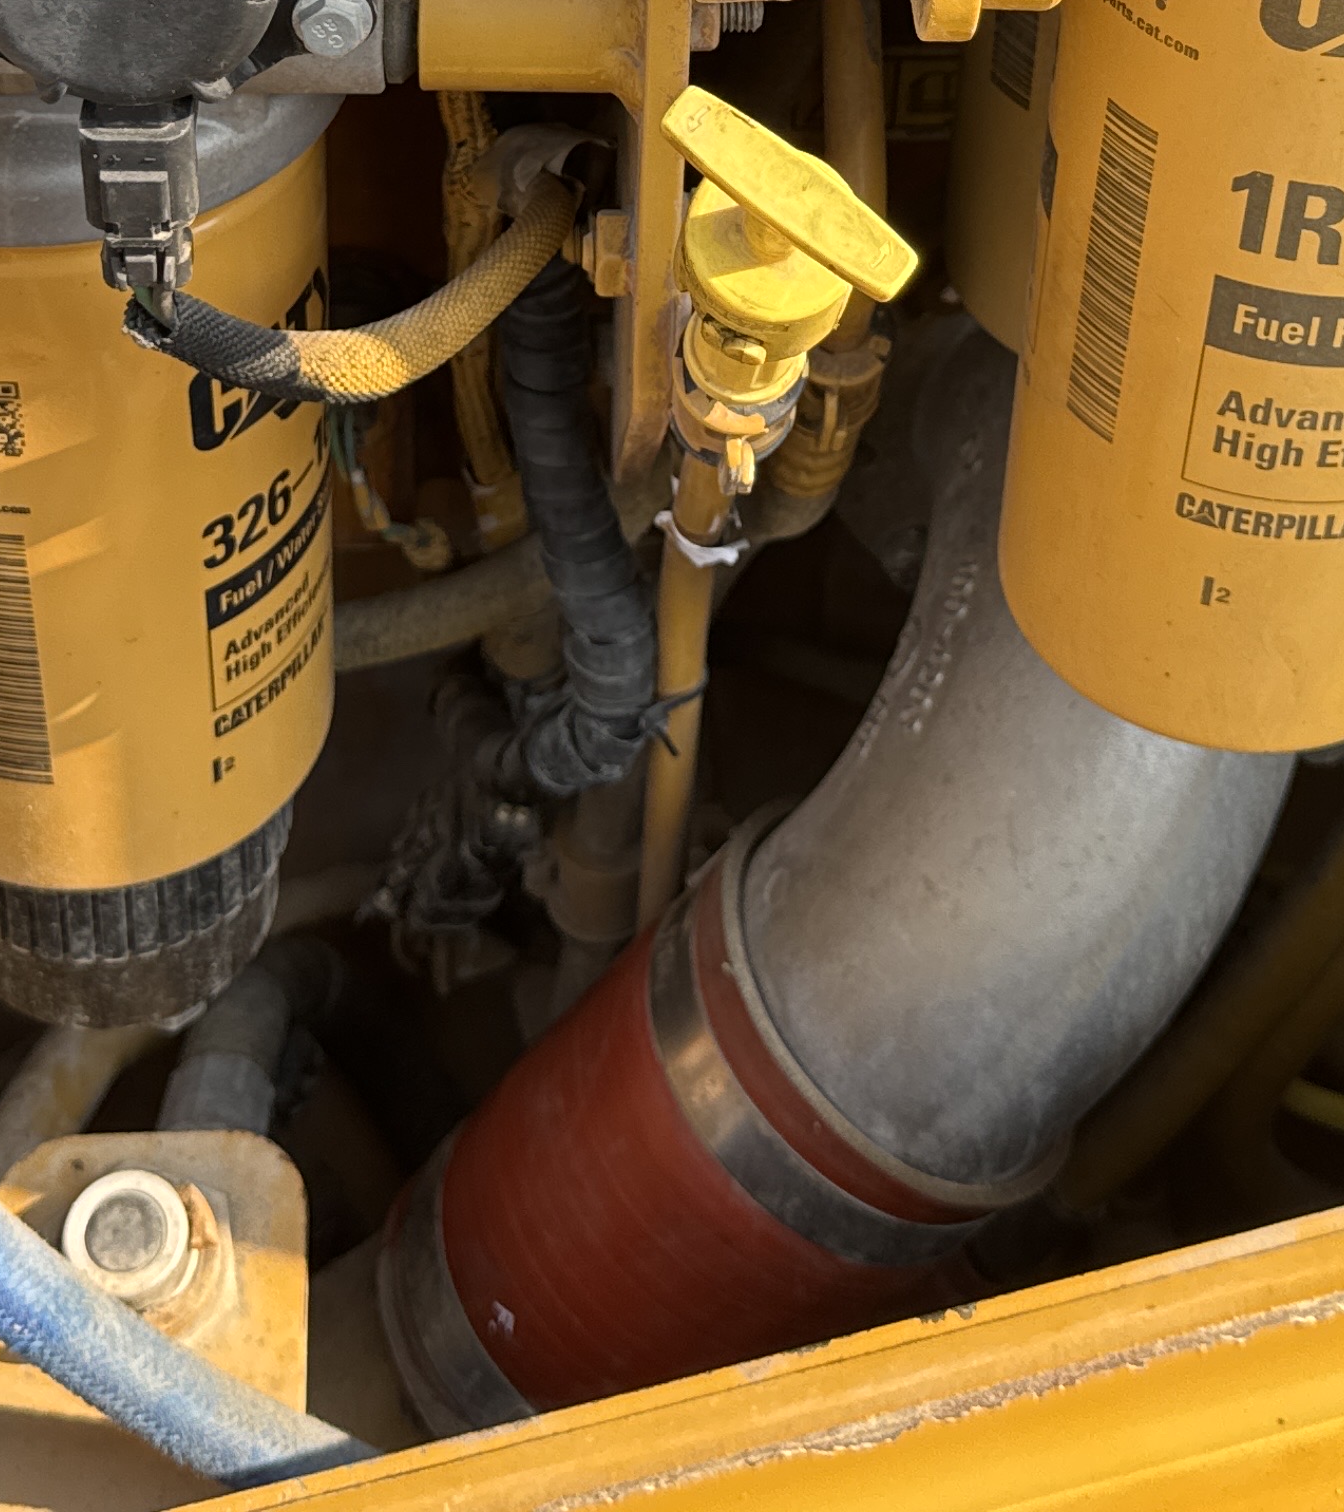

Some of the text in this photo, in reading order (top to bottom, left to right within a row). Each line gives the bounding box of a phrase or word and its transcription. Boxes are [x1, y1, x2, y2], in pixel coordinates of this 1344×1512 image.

[1233, 303, 1320, 348] Fuel
[1212, 427, 1305, 471] High
[224, 571, 310, 662] Advanced
[226, 639, 273, 683] High
